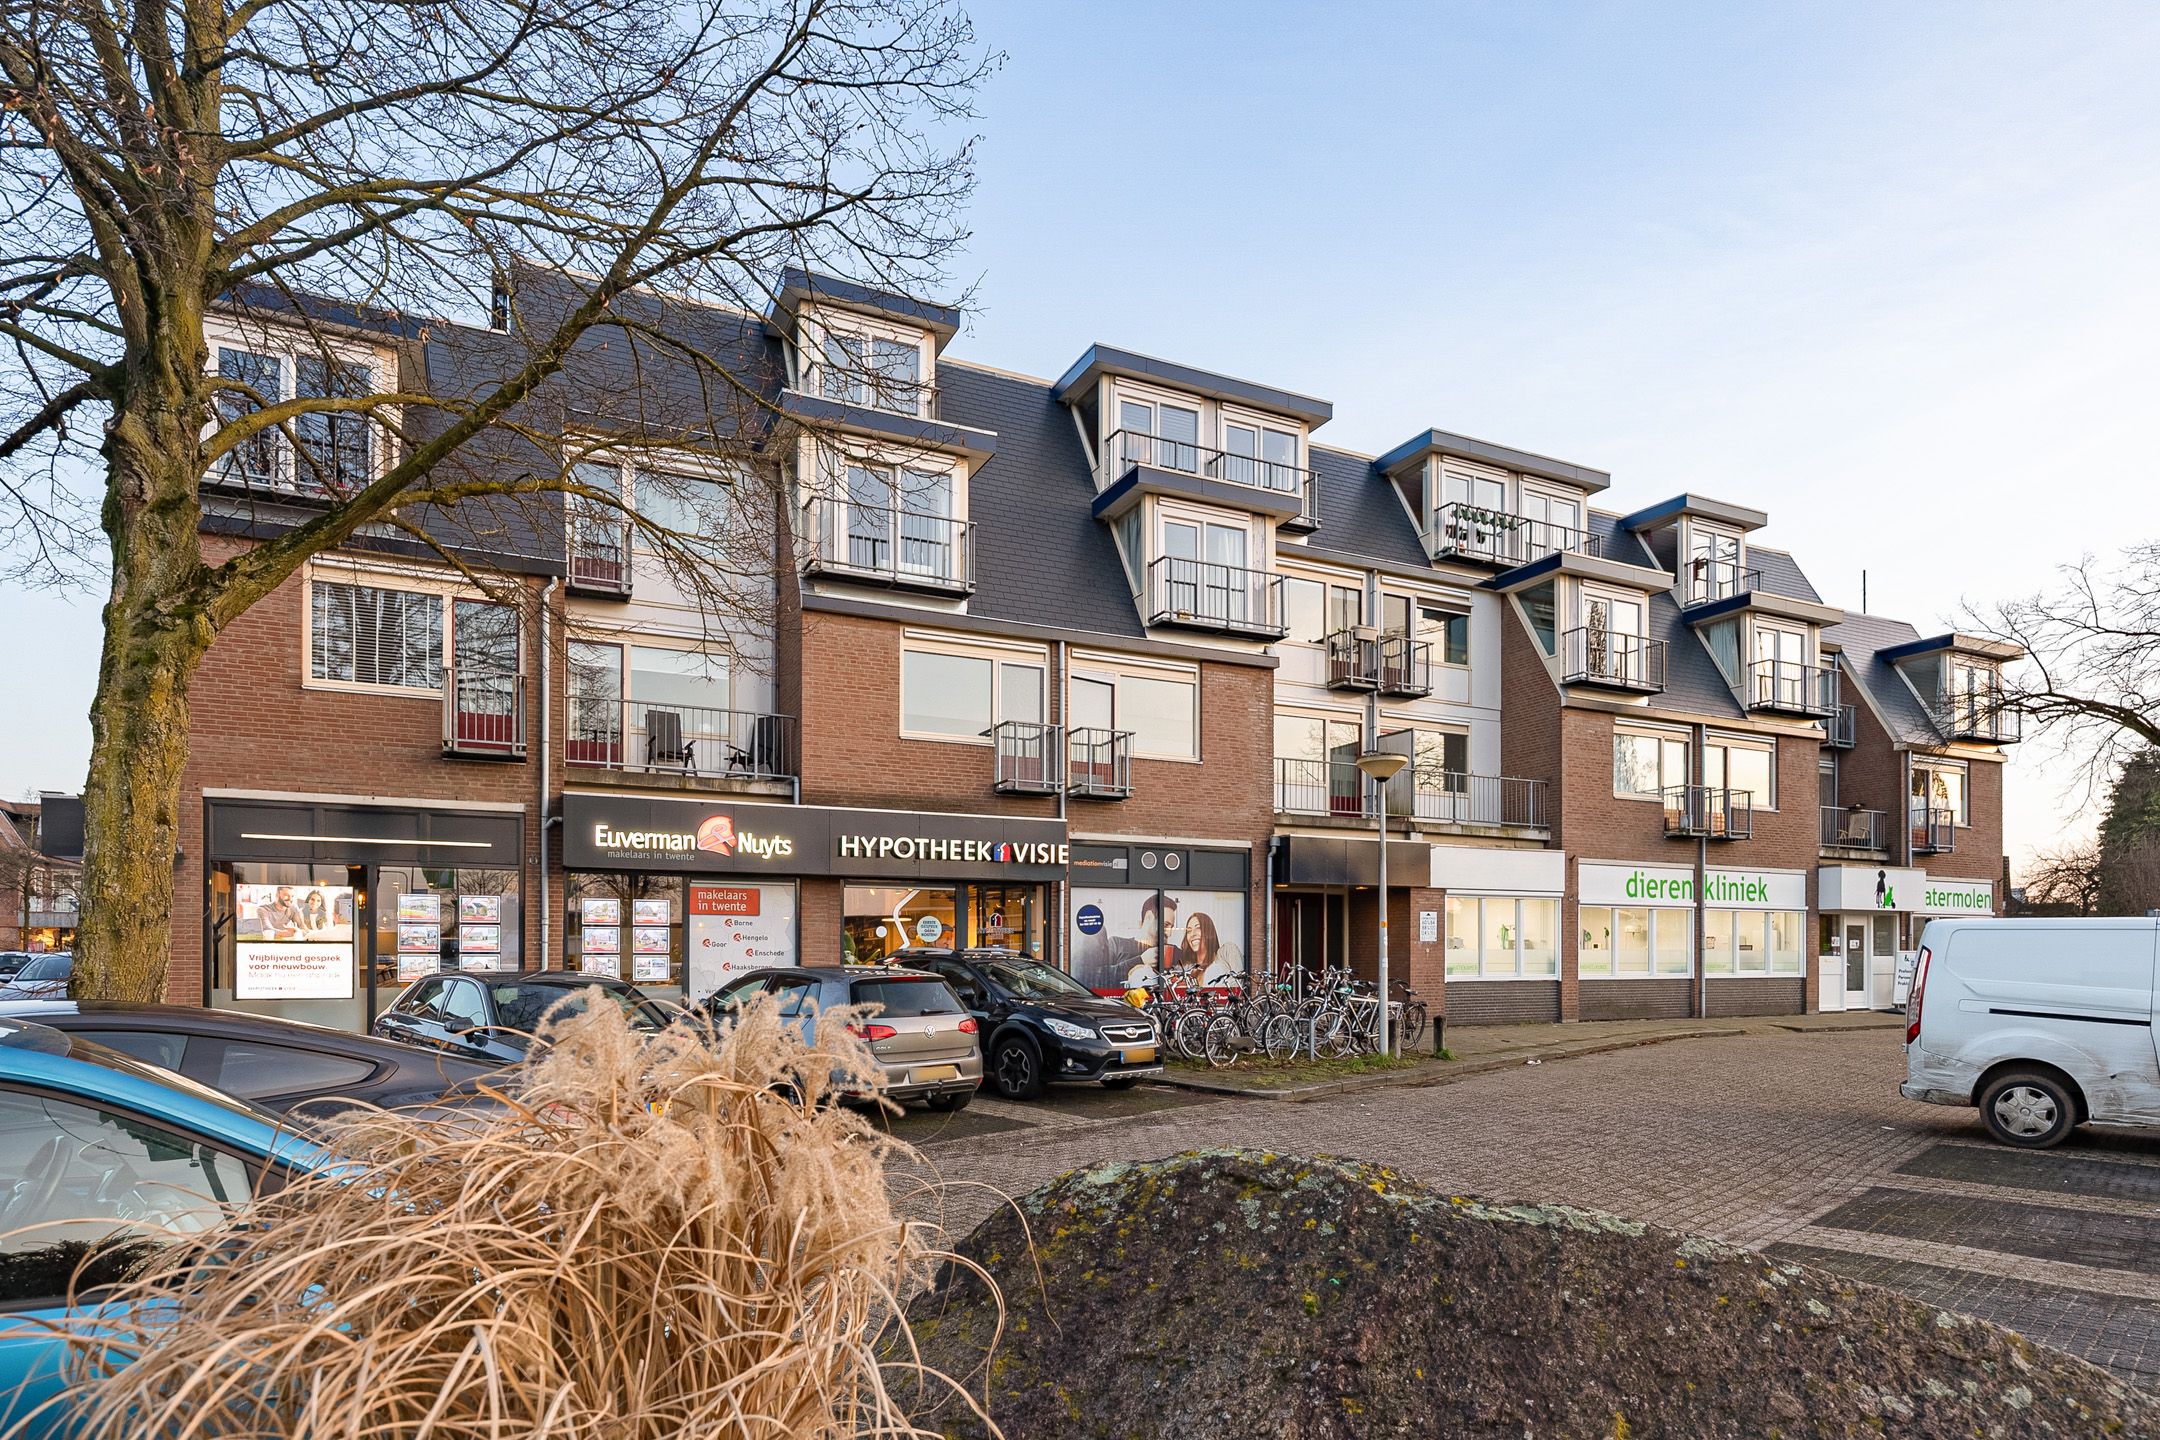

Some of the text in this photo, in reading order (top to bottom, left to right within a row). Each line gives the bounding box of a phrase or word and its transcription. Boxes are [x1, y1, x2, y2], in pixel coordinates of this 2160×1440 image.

[595, 824, 792, 859] Euverman Nuyts
[607, 850, 695, 861] makelaars in twente
[840, 835, 1069, 864] HYPOTHEEK VISIE
[1625, 871, 1769, 902] dieren kliniek
[697, 889, 748, 900] makelaars
[1925, 888, 1992, 908] atermolen
[697, 901, 747, 911] in twente
[248, 954, 341, 963] Vrijblijvend gesprek
